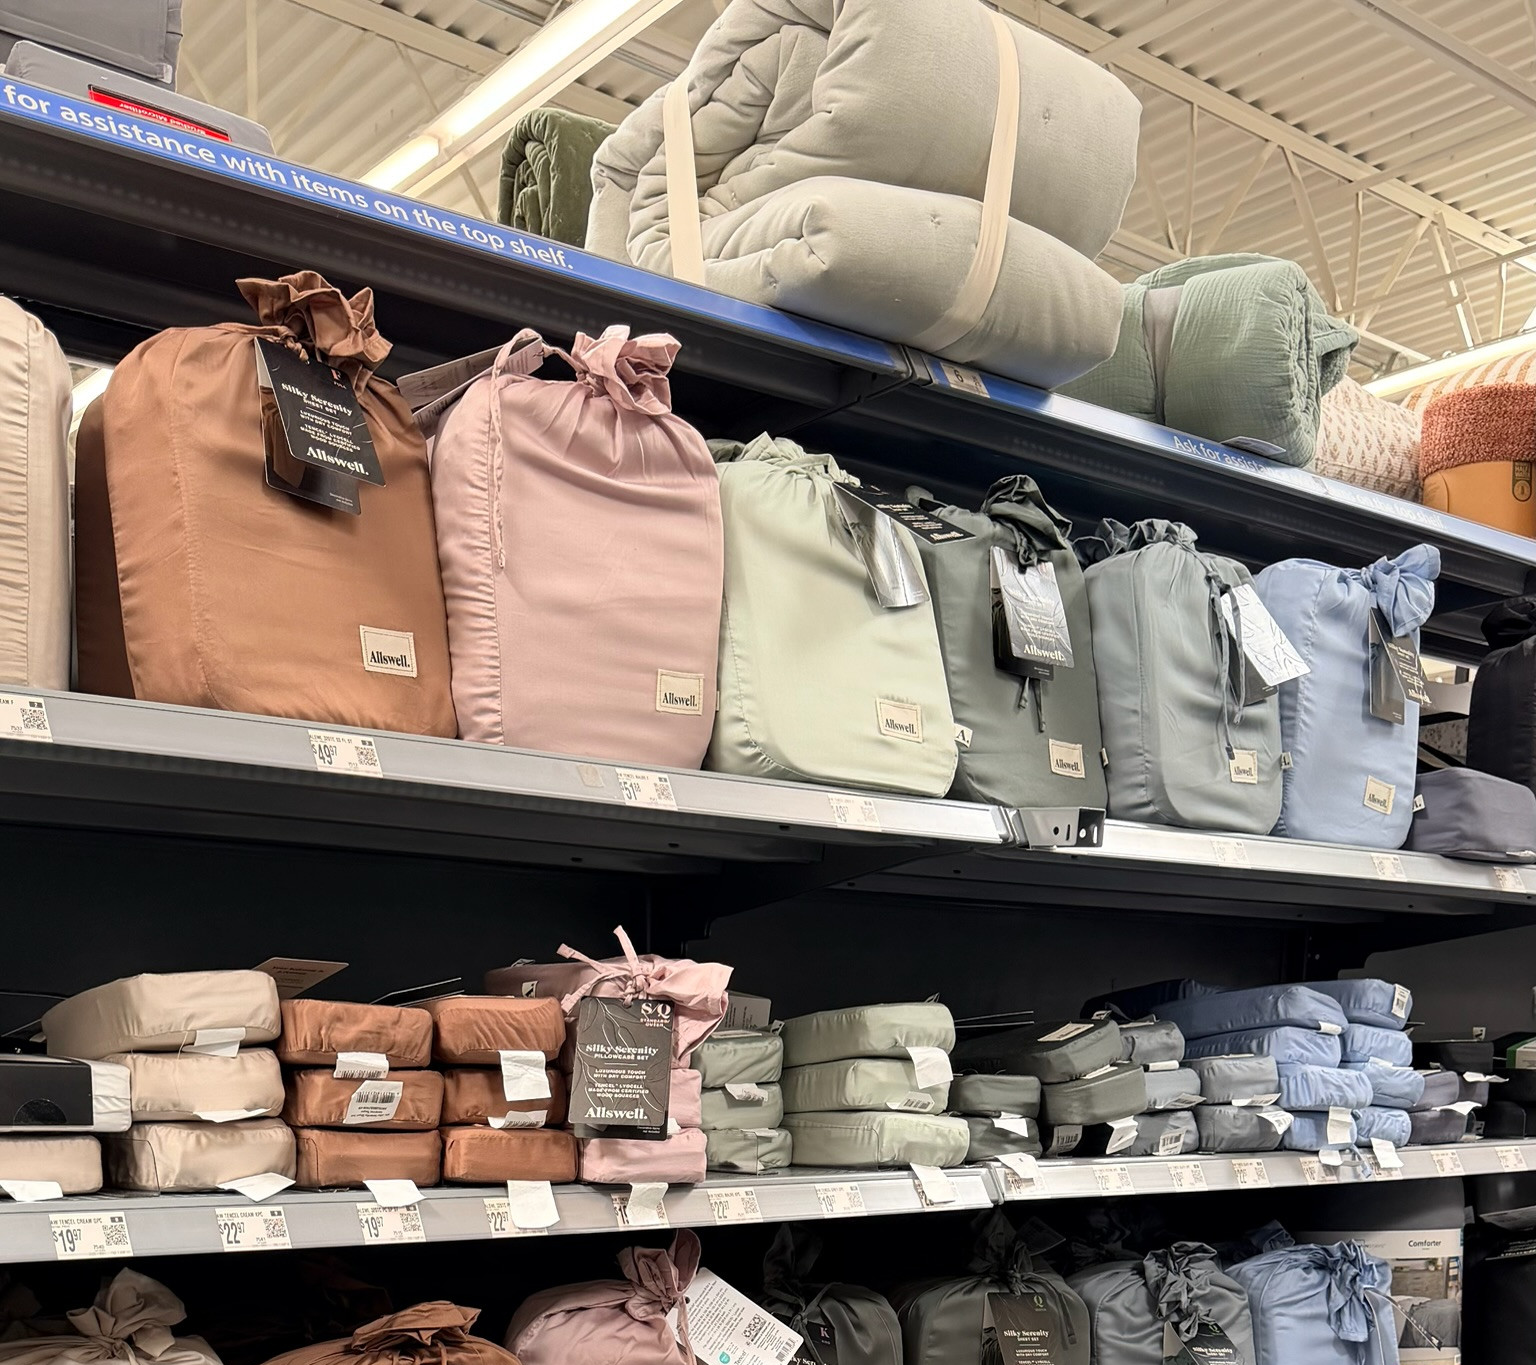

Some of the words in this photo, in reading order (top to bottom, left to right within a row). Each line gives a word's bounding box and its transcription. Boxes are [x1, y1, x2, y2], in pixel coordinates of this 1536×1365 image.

[4, 84, 51, 115] for
[60, 104, 217, 165] assistance
[220, 152, 287, 186] with
[292, 170, 370, 209] items
[374, 198, 410, 222] on
[412, 208, 458, 236] the
[460, 223, 505, 250] top
[510, 238, 574, 270] shelf.
[281, 383, 309, 401] Silky
[310, 394, 353, 416] Serenity
[1172, 434, 1198, 452] Ask
[1199, 441, 1222, 463] for
[307, 446, 370, 476] Allswell.
[369, 650, 411, 668] Allswell.
[1023, 643, 1066, 662] Allswell.
[662, 691, 698, 708] Allswell.
[884, 717, 917, 735] Allswell.
[956, 729, 970, 744] A.
[1054, 758, 1081, 772] Allswell.
[585, 1043, 613, 1055] Silky
[615, 1044, 659, 1057] Serenity
[584, 1106, 649, 1120] Allswell.
[1407, 1239, 1442, 1248] Comforter
[1021, 1329, 1050, 1338] Serenity
